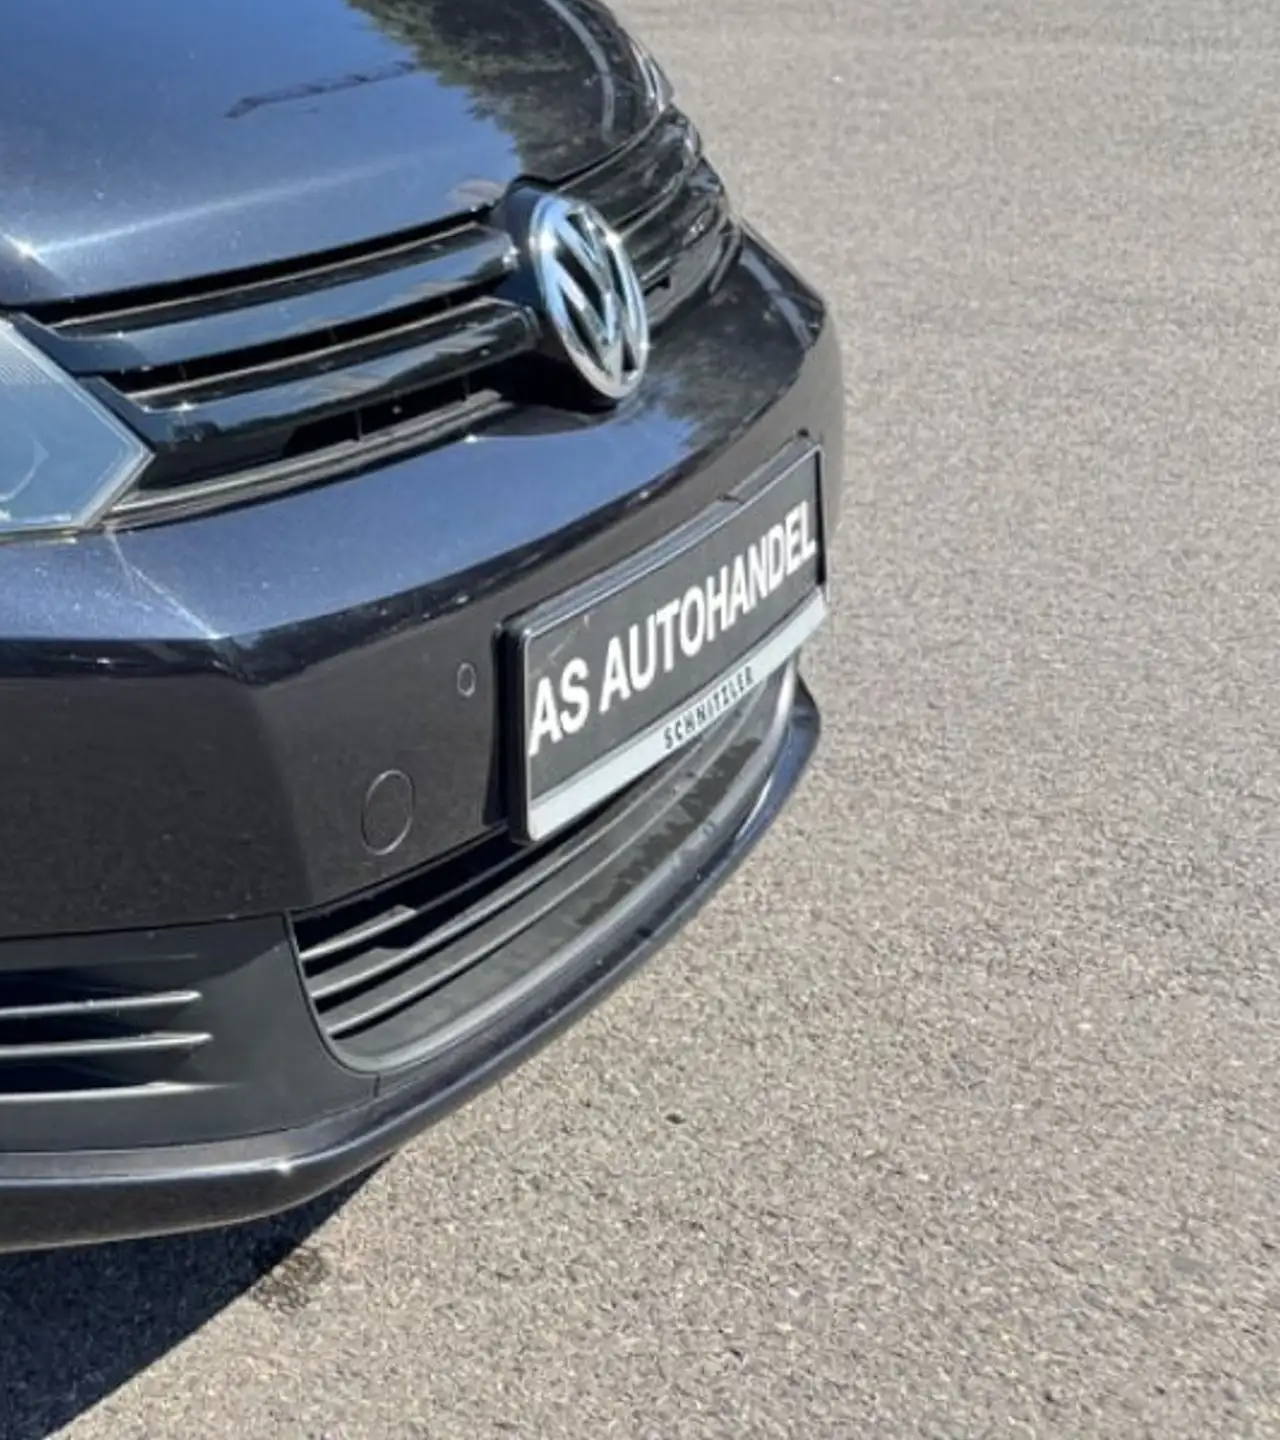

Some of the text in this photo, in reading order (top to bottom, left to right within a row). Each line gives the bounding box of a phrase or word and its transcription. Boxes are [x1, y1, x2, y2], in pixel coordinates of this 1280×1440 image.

[528, 500, 817, 757] AS AUTOHANDEL
[663, 666, 754, 750] SCHNITZLER
